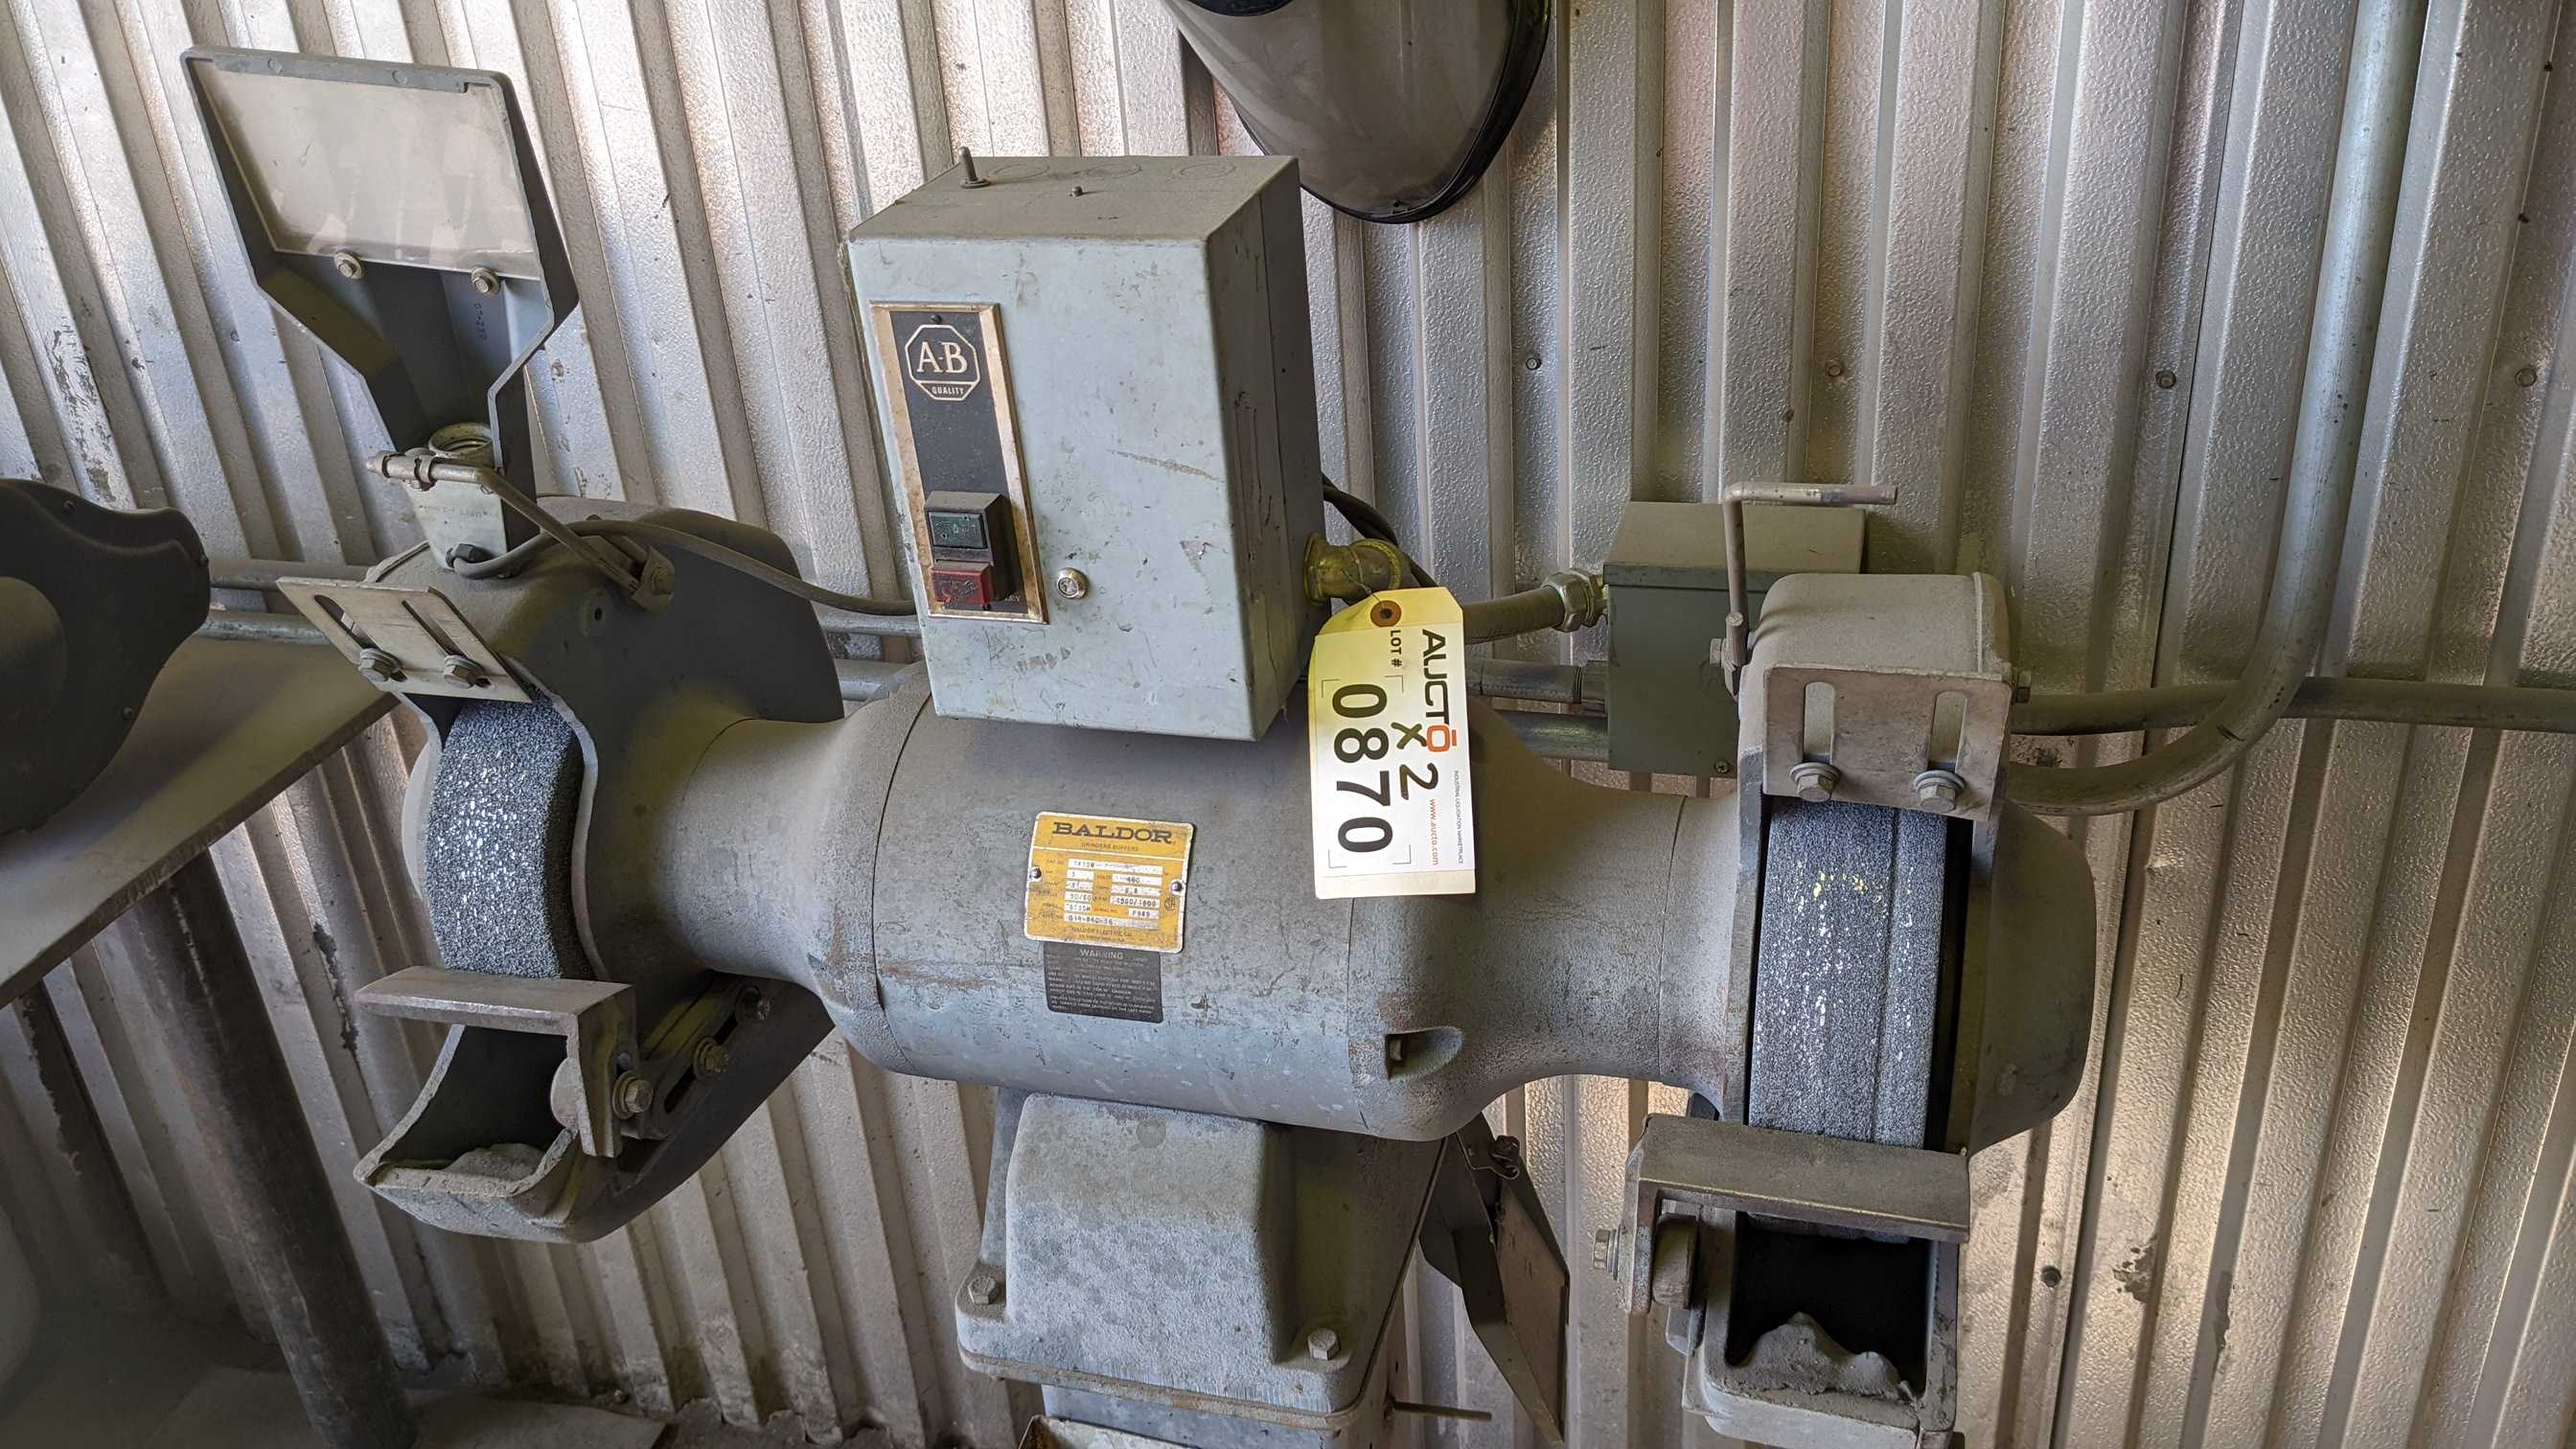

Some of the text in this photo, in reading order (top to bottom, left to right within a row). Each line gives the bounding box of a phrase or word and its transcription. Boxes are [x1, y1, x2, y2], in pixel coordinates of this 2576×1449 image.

[932, 386, 964, 395] QUALITY
[1390, 630, 1402, 667] LOT #
[1331, 683, 1393, 853] 0870
[1399, 763, 1438, 800] 2
[1052, 821, 1173, 844] BALDOR
[1429, 798, 1439, 865] www.aucto.com
